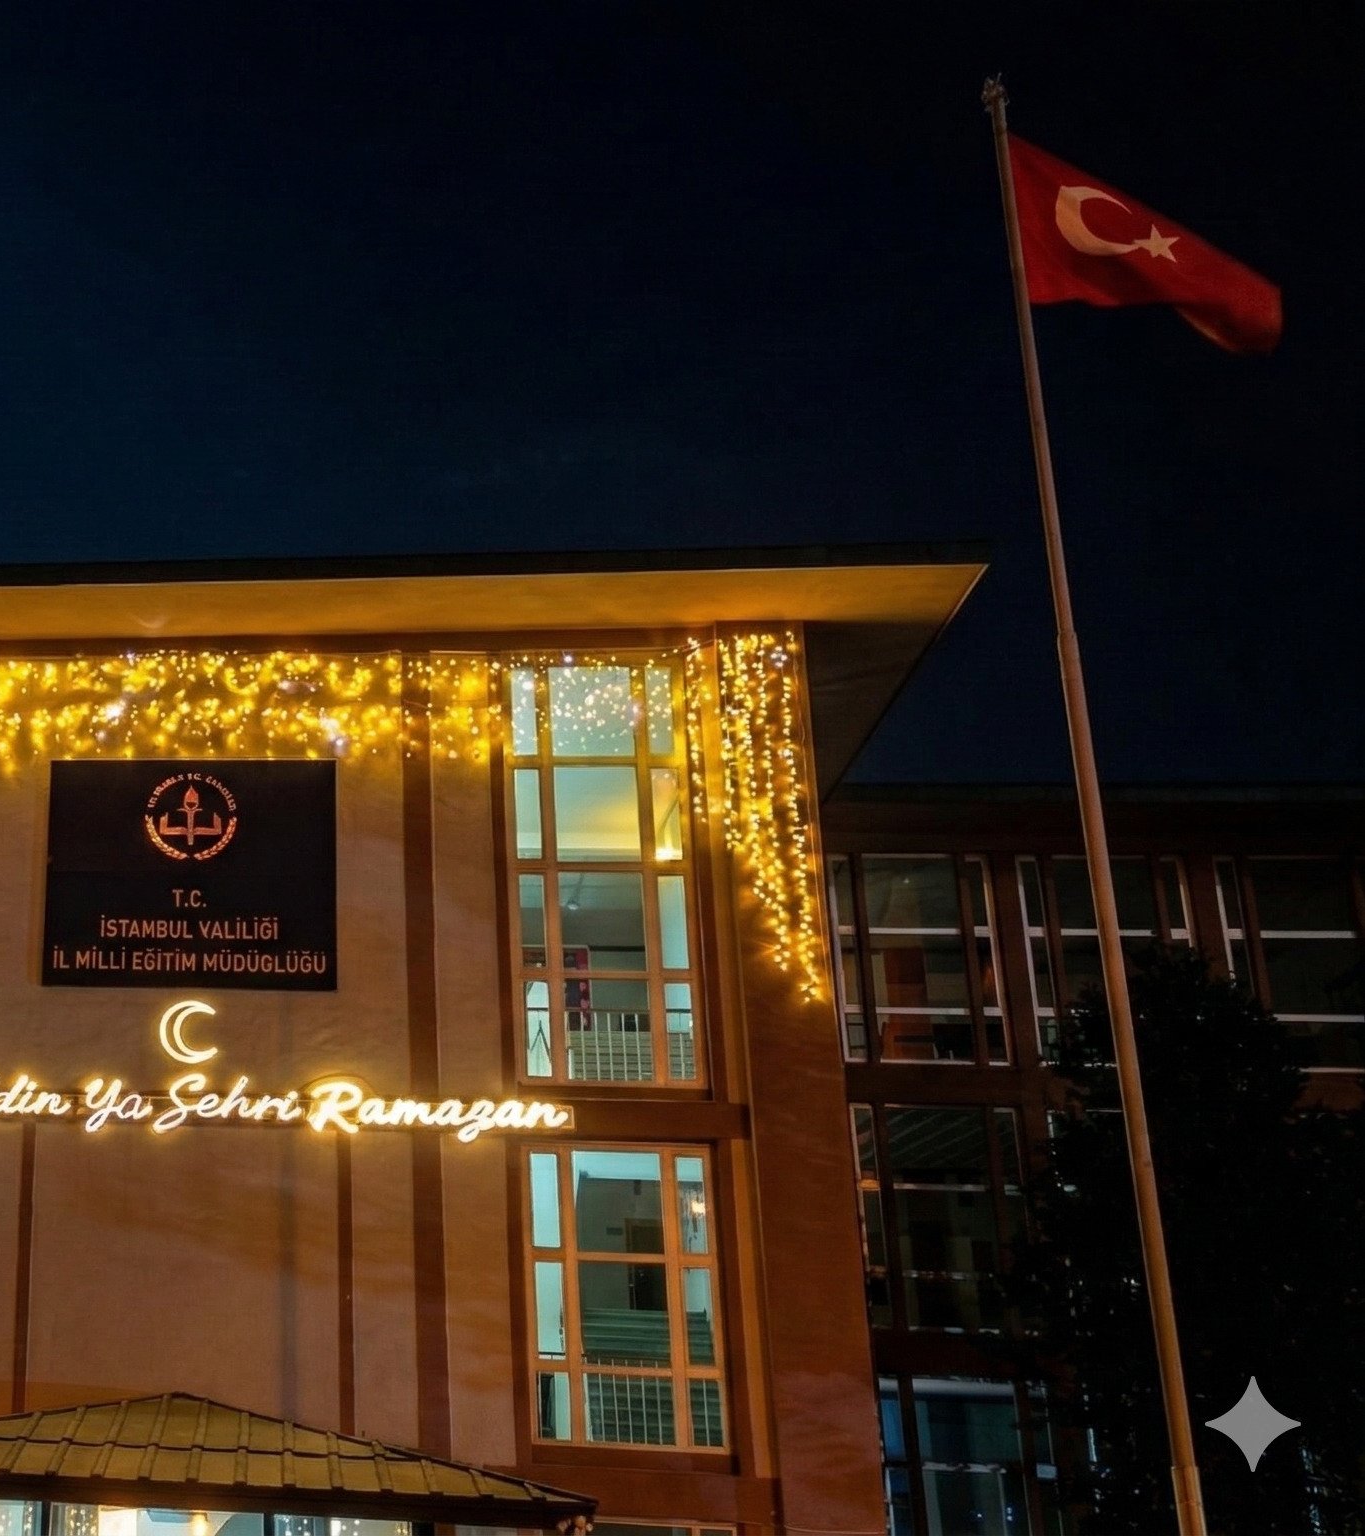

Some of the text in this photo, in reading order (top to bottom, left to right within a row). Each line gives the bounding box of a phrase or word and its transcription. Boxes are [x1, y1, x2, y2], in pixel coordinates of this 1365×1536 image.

[172, 889, 207, 907] T.C.
[100, 914, 278, 940] İSTAMBUL VALİLİĞİ
[53, 945, 70, 969] İL
[75, 946, 126, 970] MİLLİ
[132, 948, 197, 972] EĞİTİM
[84, 1077, 153, 1133] Ya
[307, 1080, 570, 1143] Ramazan
